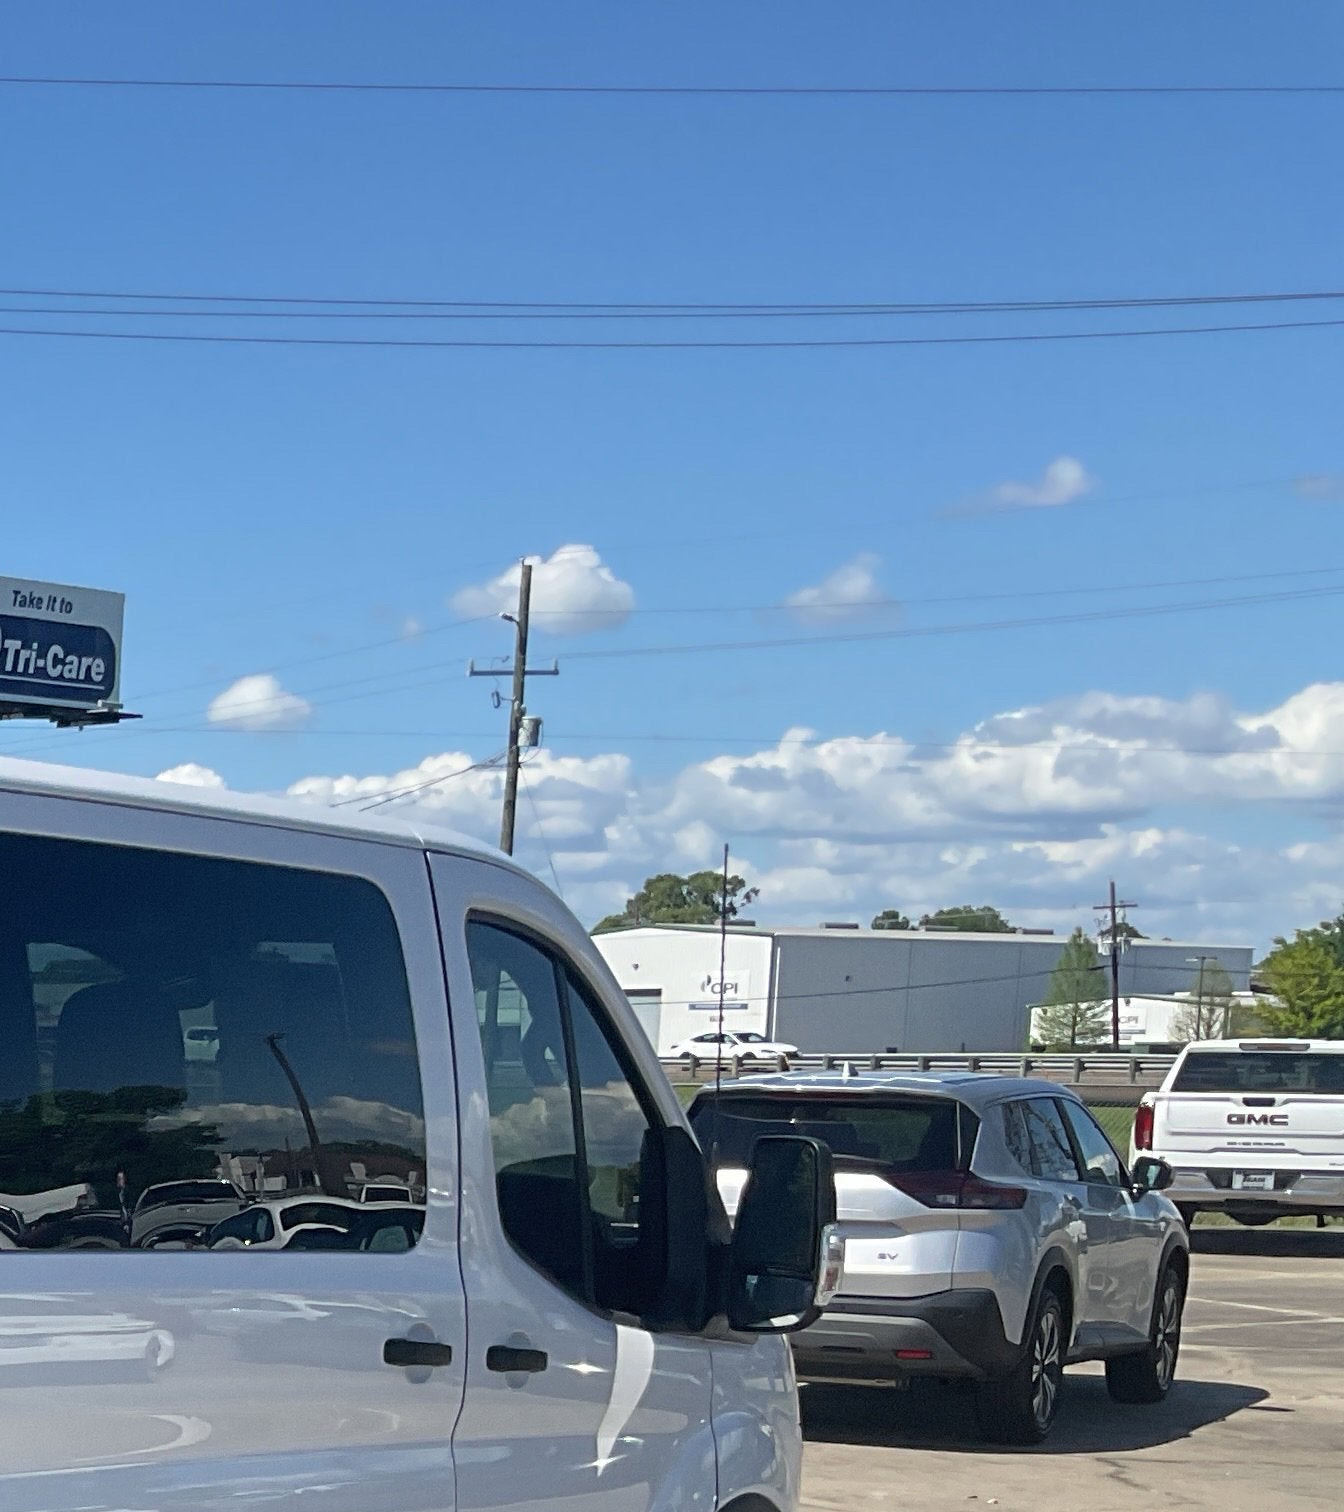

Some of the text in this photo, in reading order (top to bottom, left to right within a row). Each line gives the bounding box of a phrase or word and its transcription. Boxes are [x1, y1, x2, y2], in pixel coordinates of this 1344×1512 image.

[13, 590, 43, 610] Take
[59, 597, 73, 614] to
[3, 639, 105, 682] Tri-Care
[1226, 1113, 1289, 1126] GMC
